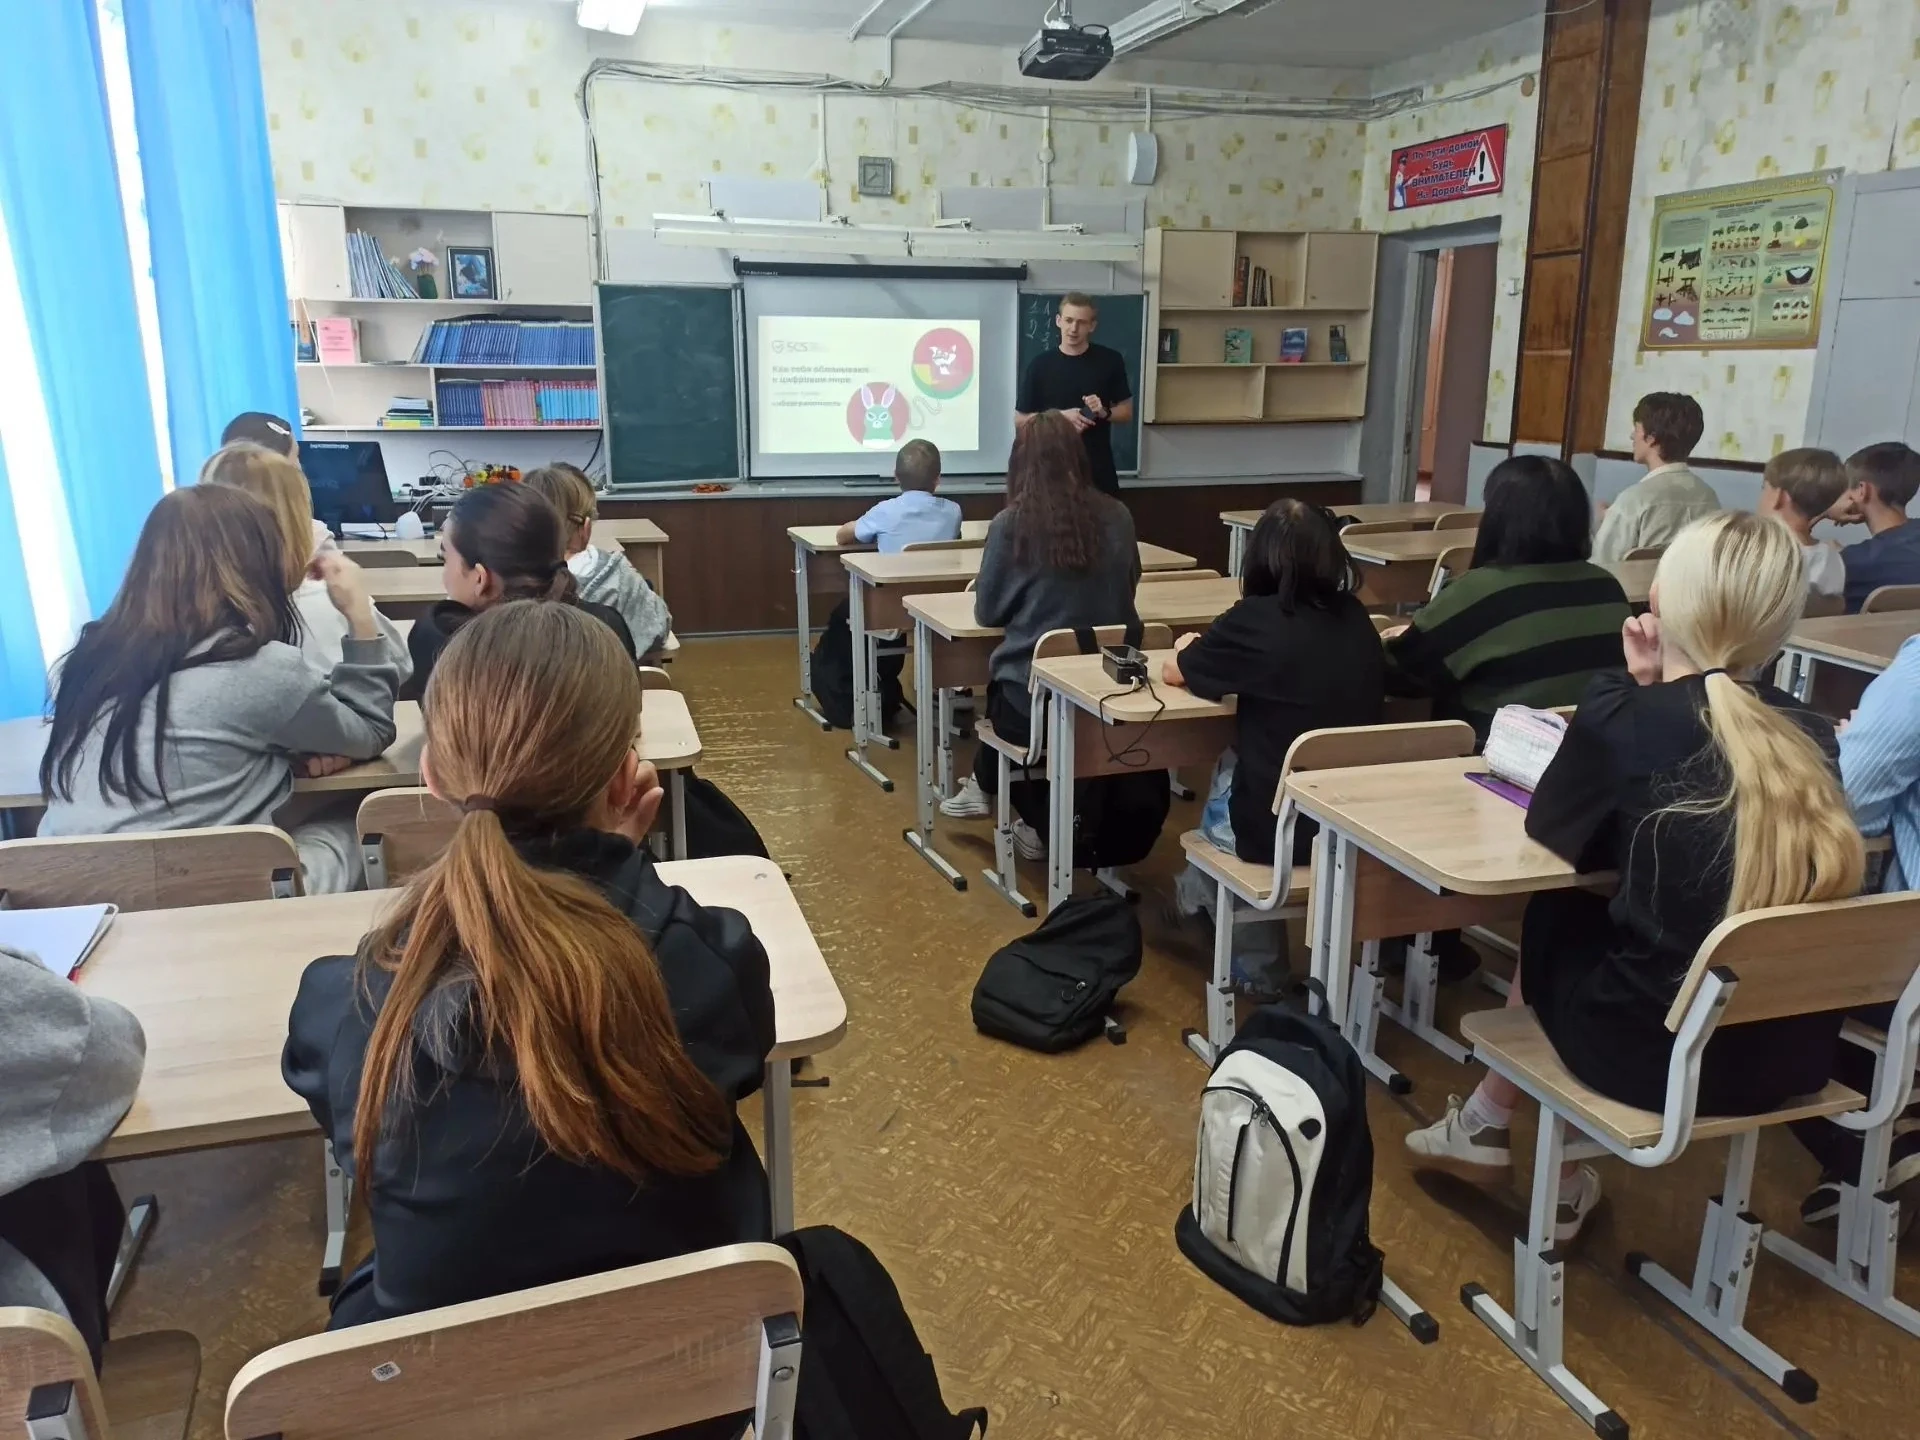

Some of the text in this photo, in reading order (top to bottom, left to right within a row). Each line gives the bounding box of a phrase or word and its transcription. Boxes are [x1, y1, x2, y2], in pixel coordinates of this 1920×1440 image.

[1413, 138, 1480, 159] По пути домой
[1432, 159, 1454, 170] Будь
[1412, 167, 1476, 187] ВНИМАТЕЛЕН
[786, 341, 808, 352] SCS
